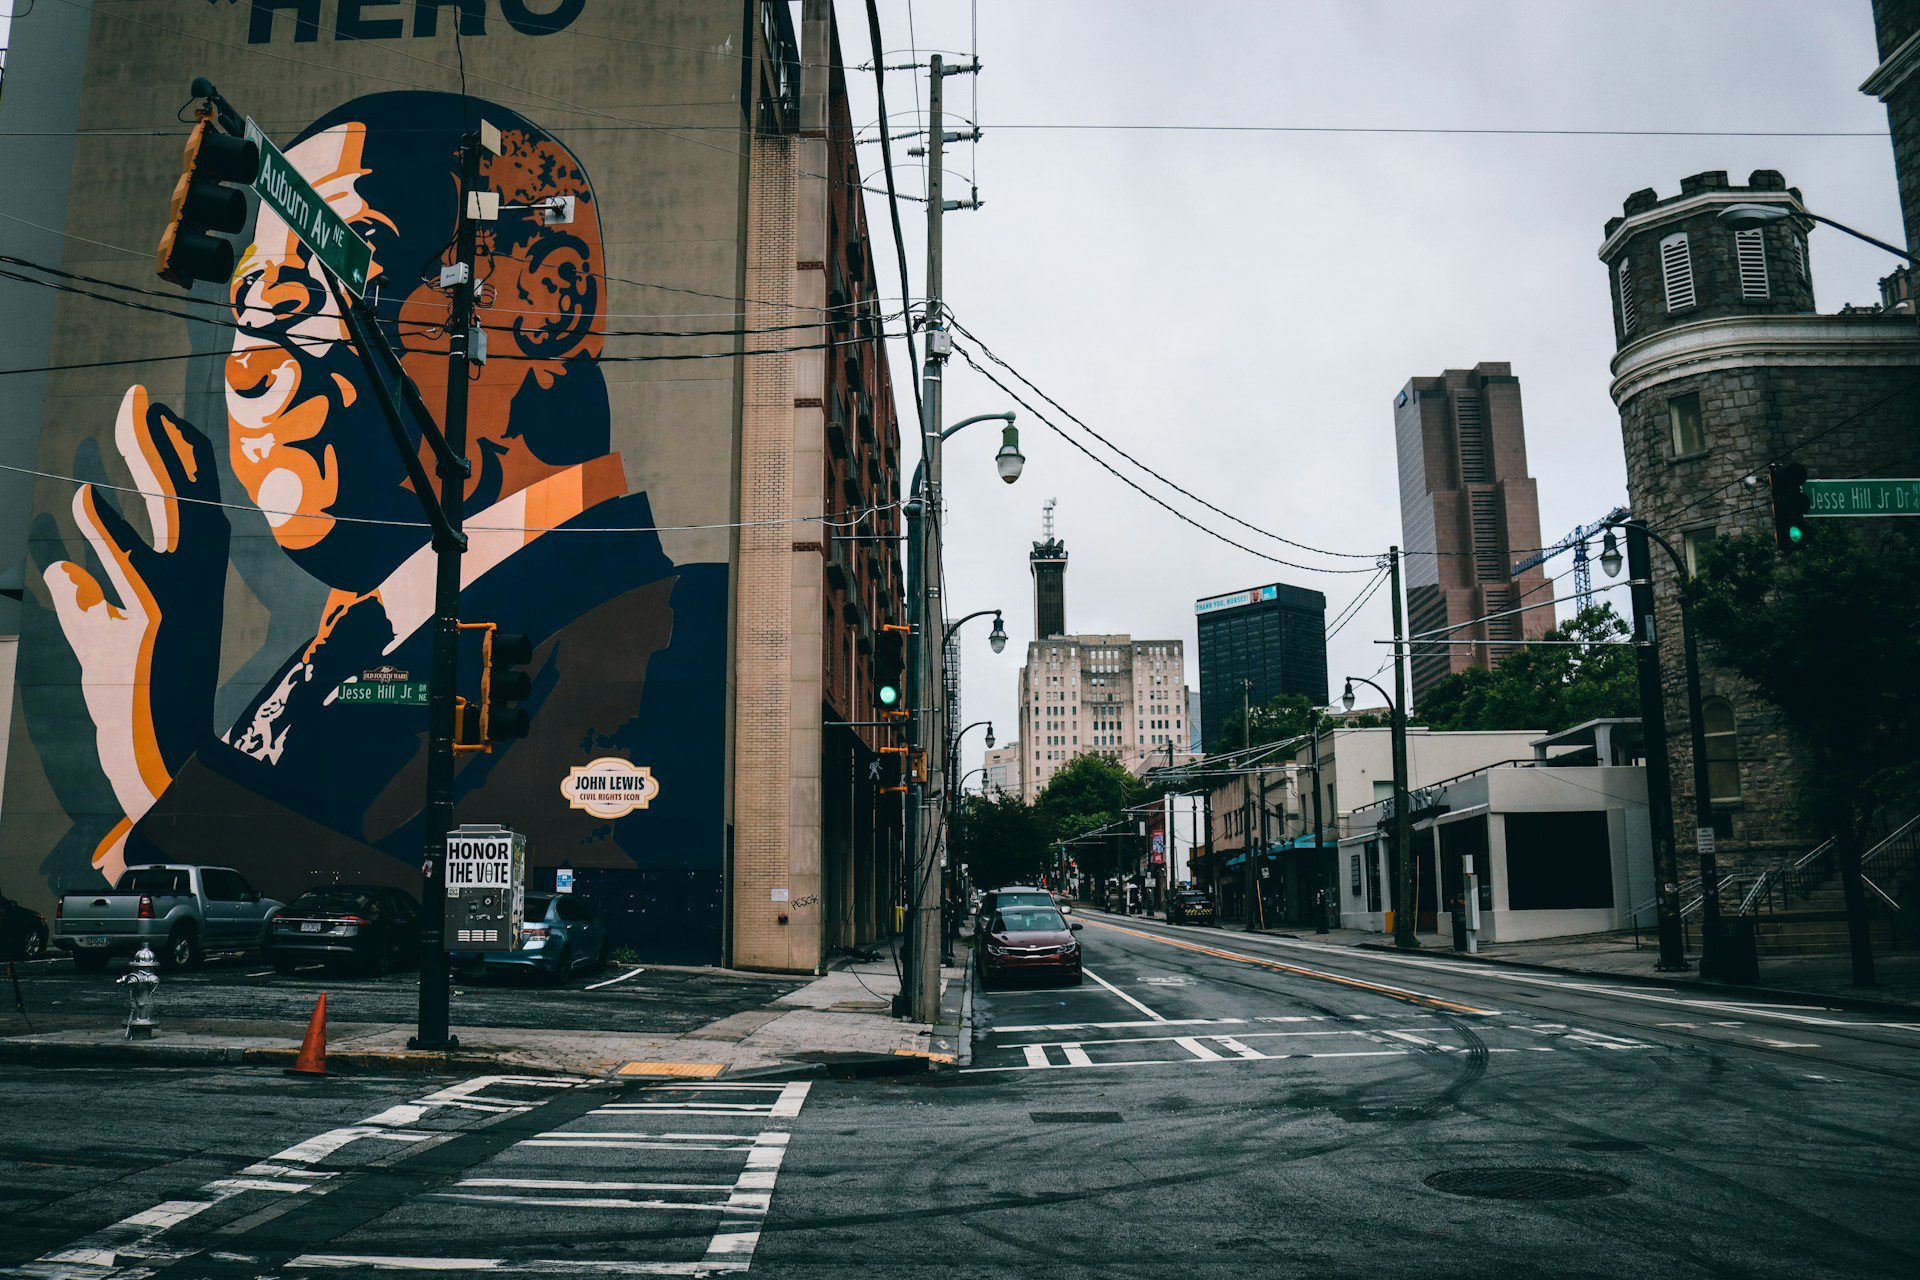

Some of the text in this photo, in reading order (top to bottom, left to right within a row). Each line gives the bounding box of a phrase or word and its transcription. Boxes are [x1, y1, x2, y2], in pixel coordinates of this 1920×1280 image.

[260, 153, 344, 250] Auburn Av NE
[1810, 487, 1845, 510] Jesse
[1851, 487, 1872, 509] Hill
[1877, 487, 1890, 509] Jr
[1896, 486, 1910, 509] Dr
[1196, 602, 1212, 611] THANK
[339, 684, 413, 700] Jesse Hill Jr.
[418, 683, 427, 692] DR
[418, 693, 428, 702] NE
[575, 776, 645, 790] JOHN LEWIS
[579, 793, 640, 801] CIVIL RIGHTS ICON
[448, 842, 509, 860] HONOR
[449, 862, 508, 884] THE VOTE
